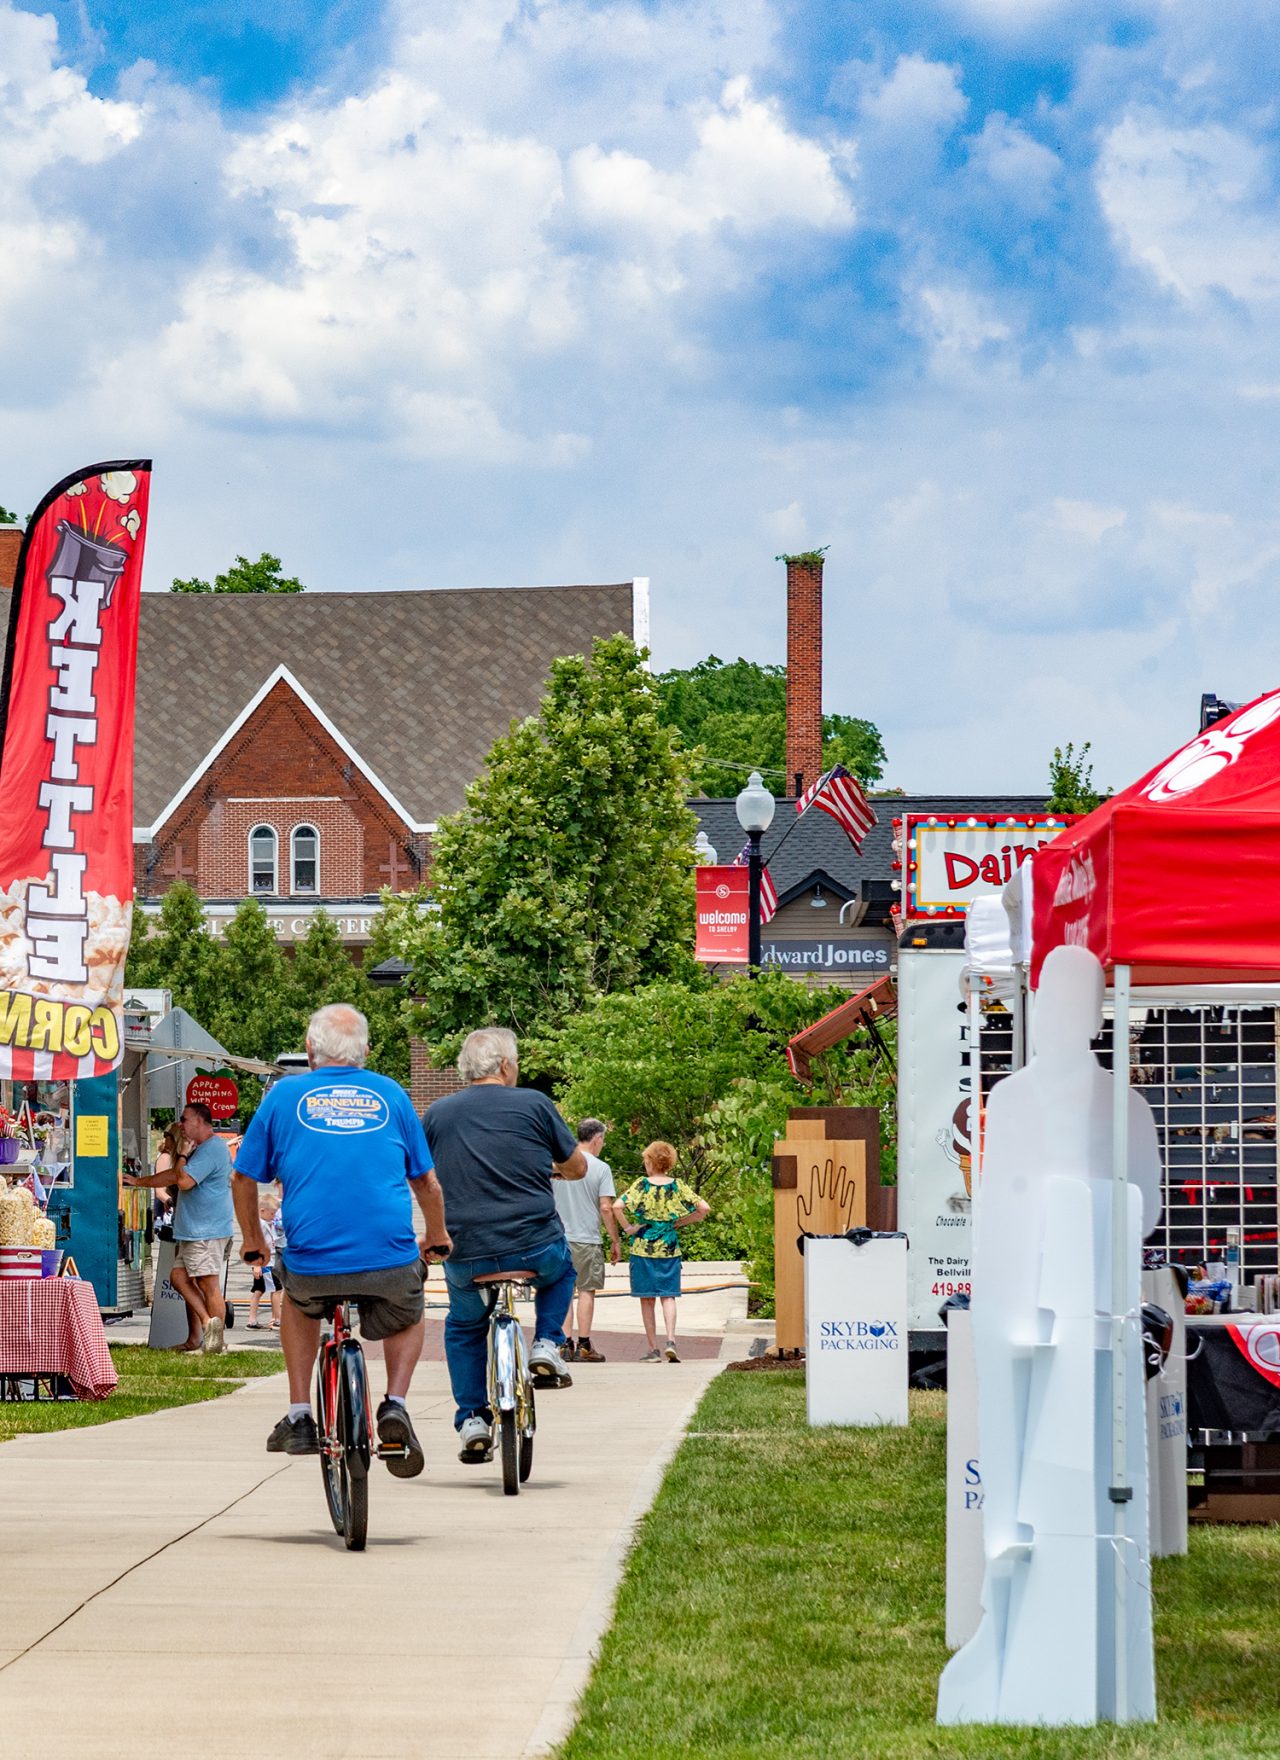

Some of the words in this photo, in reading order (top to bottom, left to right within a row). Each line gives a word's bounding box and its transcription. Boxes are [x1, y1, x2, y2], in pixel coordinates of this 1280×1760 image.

[944, 840, 1048, 890] Dair
[699, 910, 747, 925] welcome
[708, 925, 716, 933] TO
[717, 925, 738, 933] SHELBY
[824, 944, 888, 966] Jones
[306, 1097, 382, 1108] BONNEVILLE
[928, 1256, 945, 1265] The
[946, 1256, 969, 1267] Dairy
[936, 1268, 972, 1276] Bellvill
[931, 1282, 972, 1297] 419-88
[820, 1339, 899, 1350] PACKAGING
